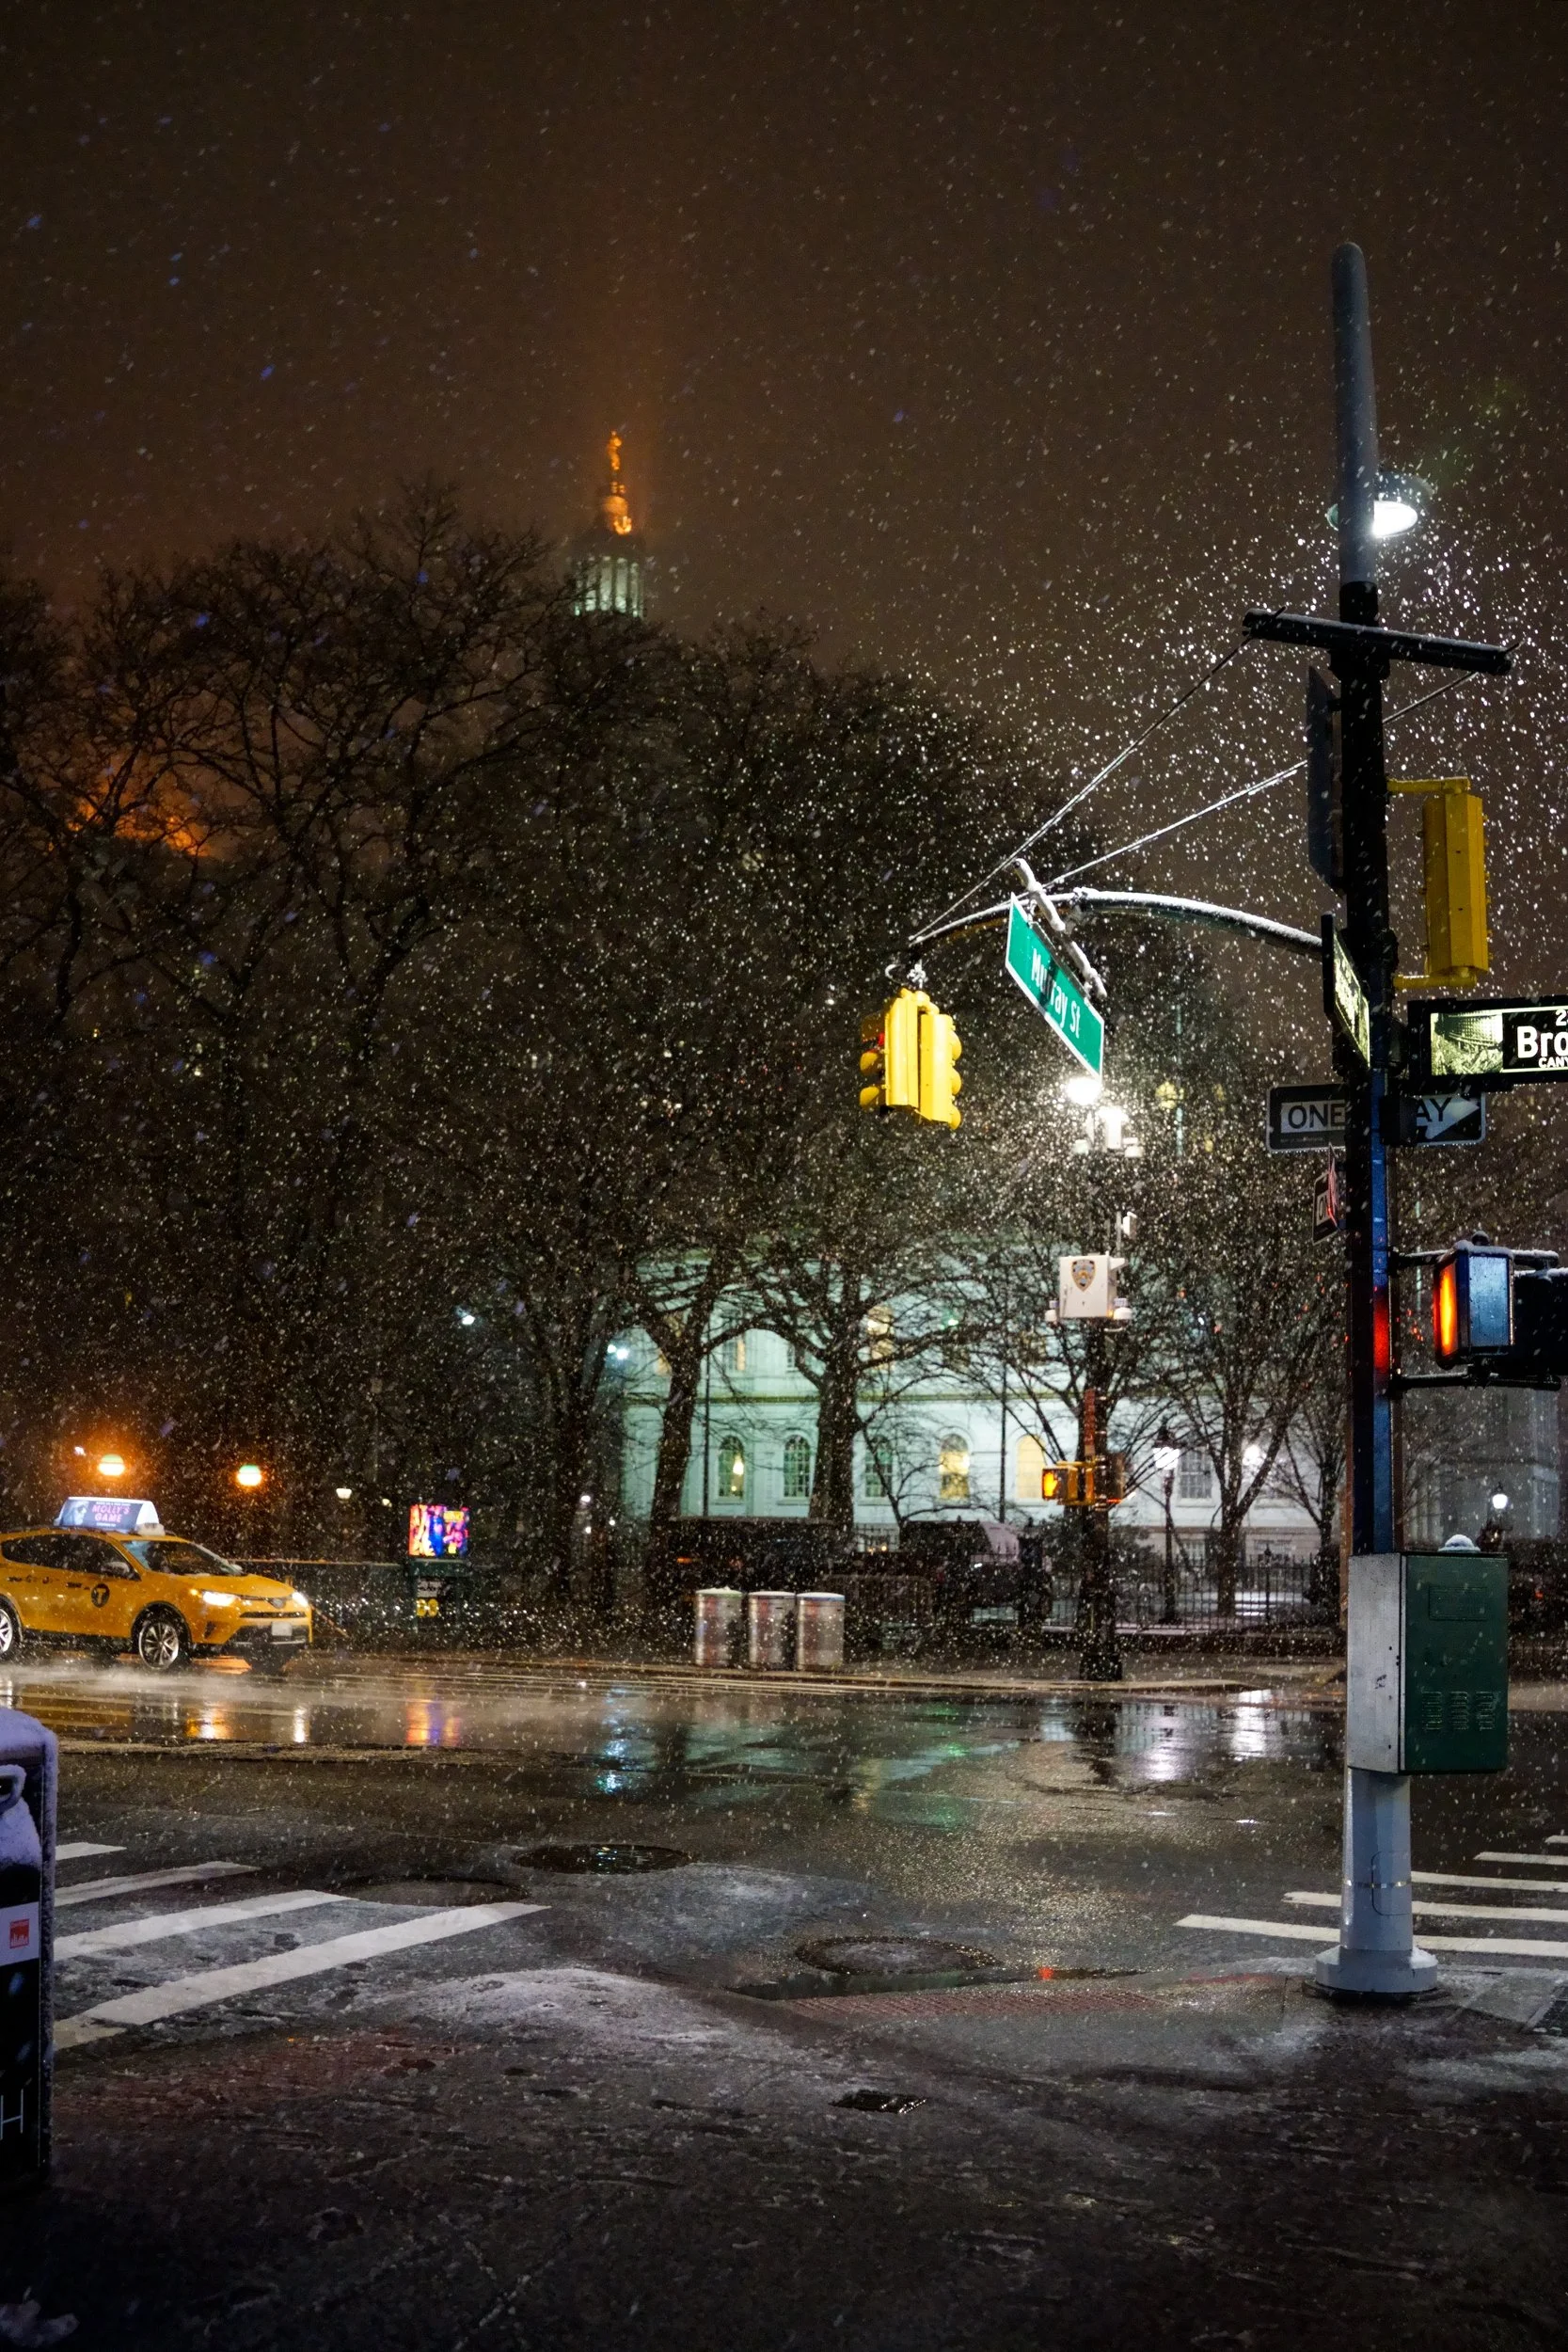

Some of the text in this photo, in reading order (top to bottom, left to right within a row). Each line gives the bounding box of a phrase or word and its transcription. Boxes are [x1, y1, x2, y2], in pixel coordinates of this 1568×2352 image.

[1031, 948, 1081, 1039] Murray St
[1288, 1104, 1345, 1129] ONE
[92, 1505, 130, 1515] MOLLY'S
[95, 1513, 122, 1522] GAME
[96, 1588, 106, 1605] T
